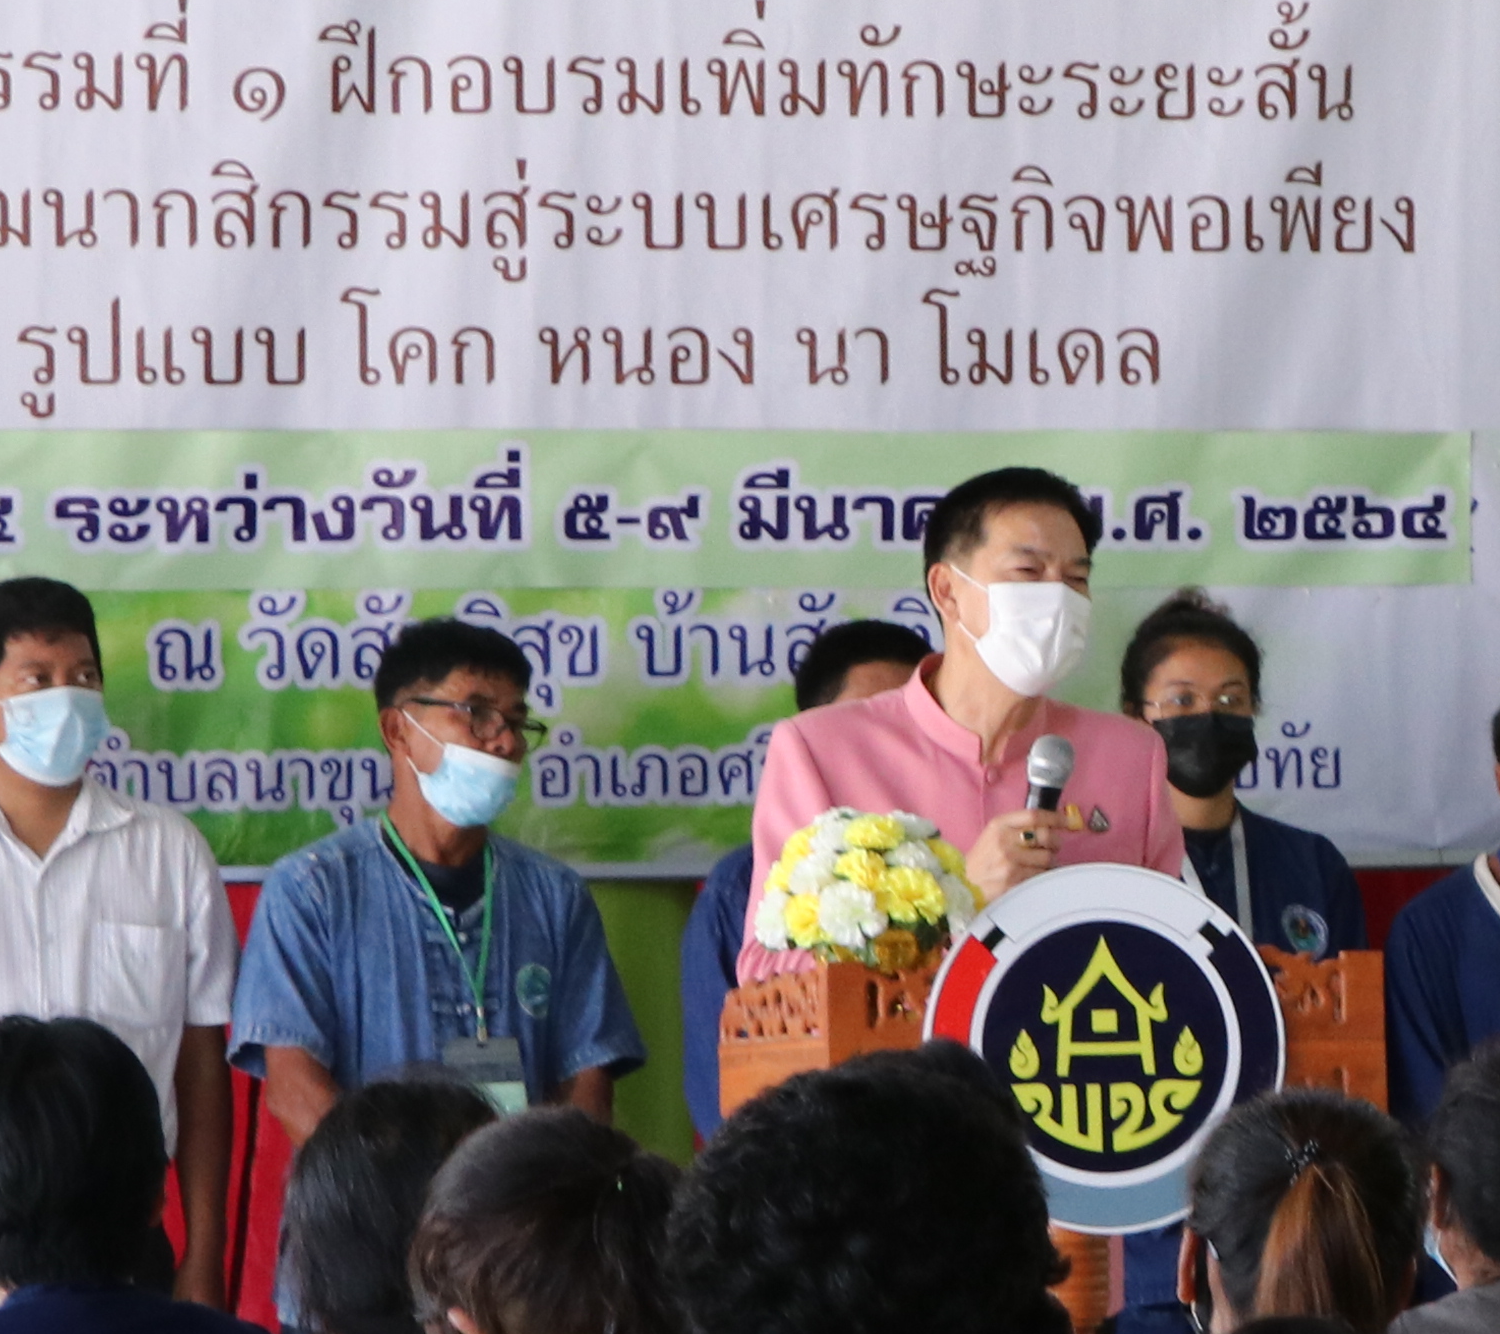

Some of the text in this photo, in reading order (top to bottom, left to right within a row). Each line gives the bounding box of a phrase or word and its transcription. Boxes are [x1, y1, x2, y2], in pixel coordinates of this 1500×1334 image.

[233, 66, 286, 120] ๑
[318, 0, 1354, 121] ฝึกอบรมเพิ่มทักษะระยะสั้น
[17, 287, 1161, 418] รูปแบบ โคก หนอง นา โมเดล
[54, 449, 522, 545] ระหว่างวันที่
[1242, 494, 1448, 541] ๒๕๖๔
[154, 626, 217, 682] ณ
